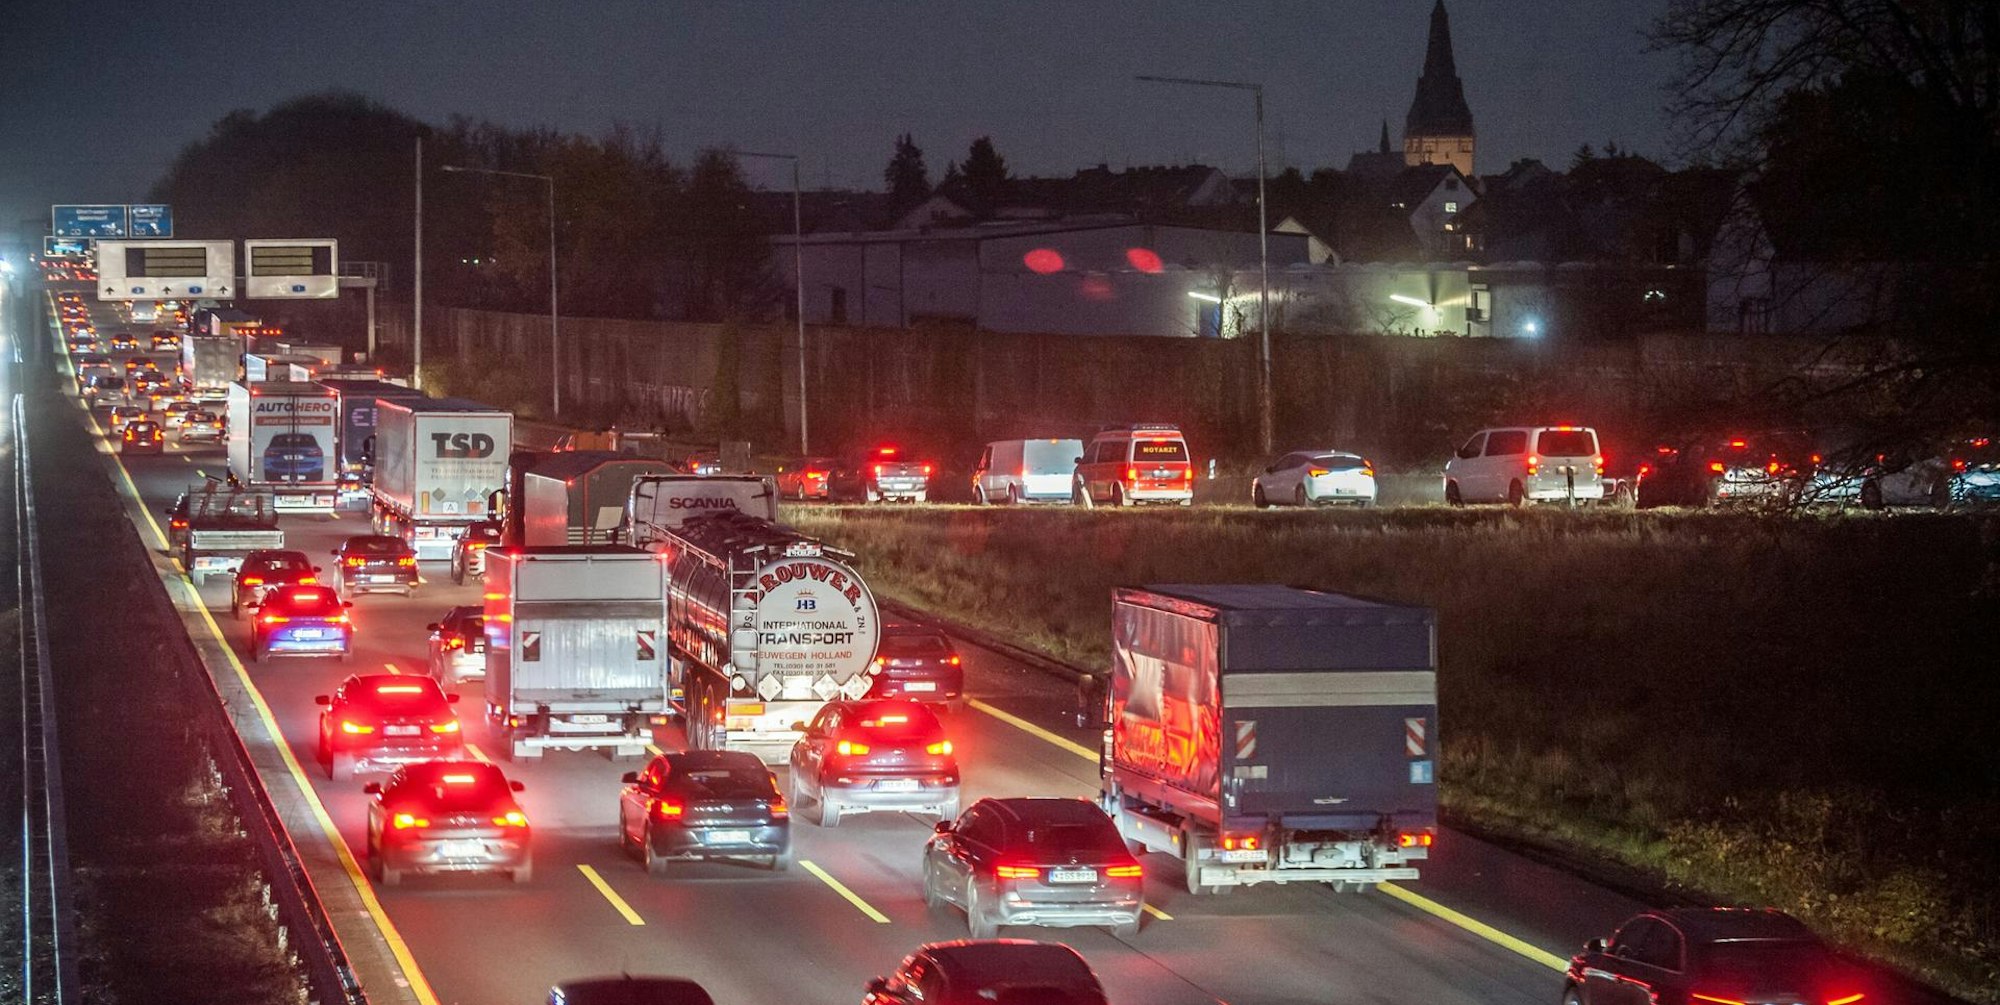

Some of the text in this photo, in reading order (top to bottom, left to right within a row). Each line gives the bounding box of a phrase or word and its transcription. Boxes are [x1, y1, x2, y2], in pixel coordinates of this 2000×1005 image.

[256, 402, 331, 412] AUTOHERO
[431, 432, 495, 458] TSD
[447, 503, 454, 511] A
[669, 497, 737, 509] SCANIA
[744, 562, 862, 606] BROUWER
[758, 632, 854, 645] TRANSPORT
[811, 651, 852, 659] HOLLAND
